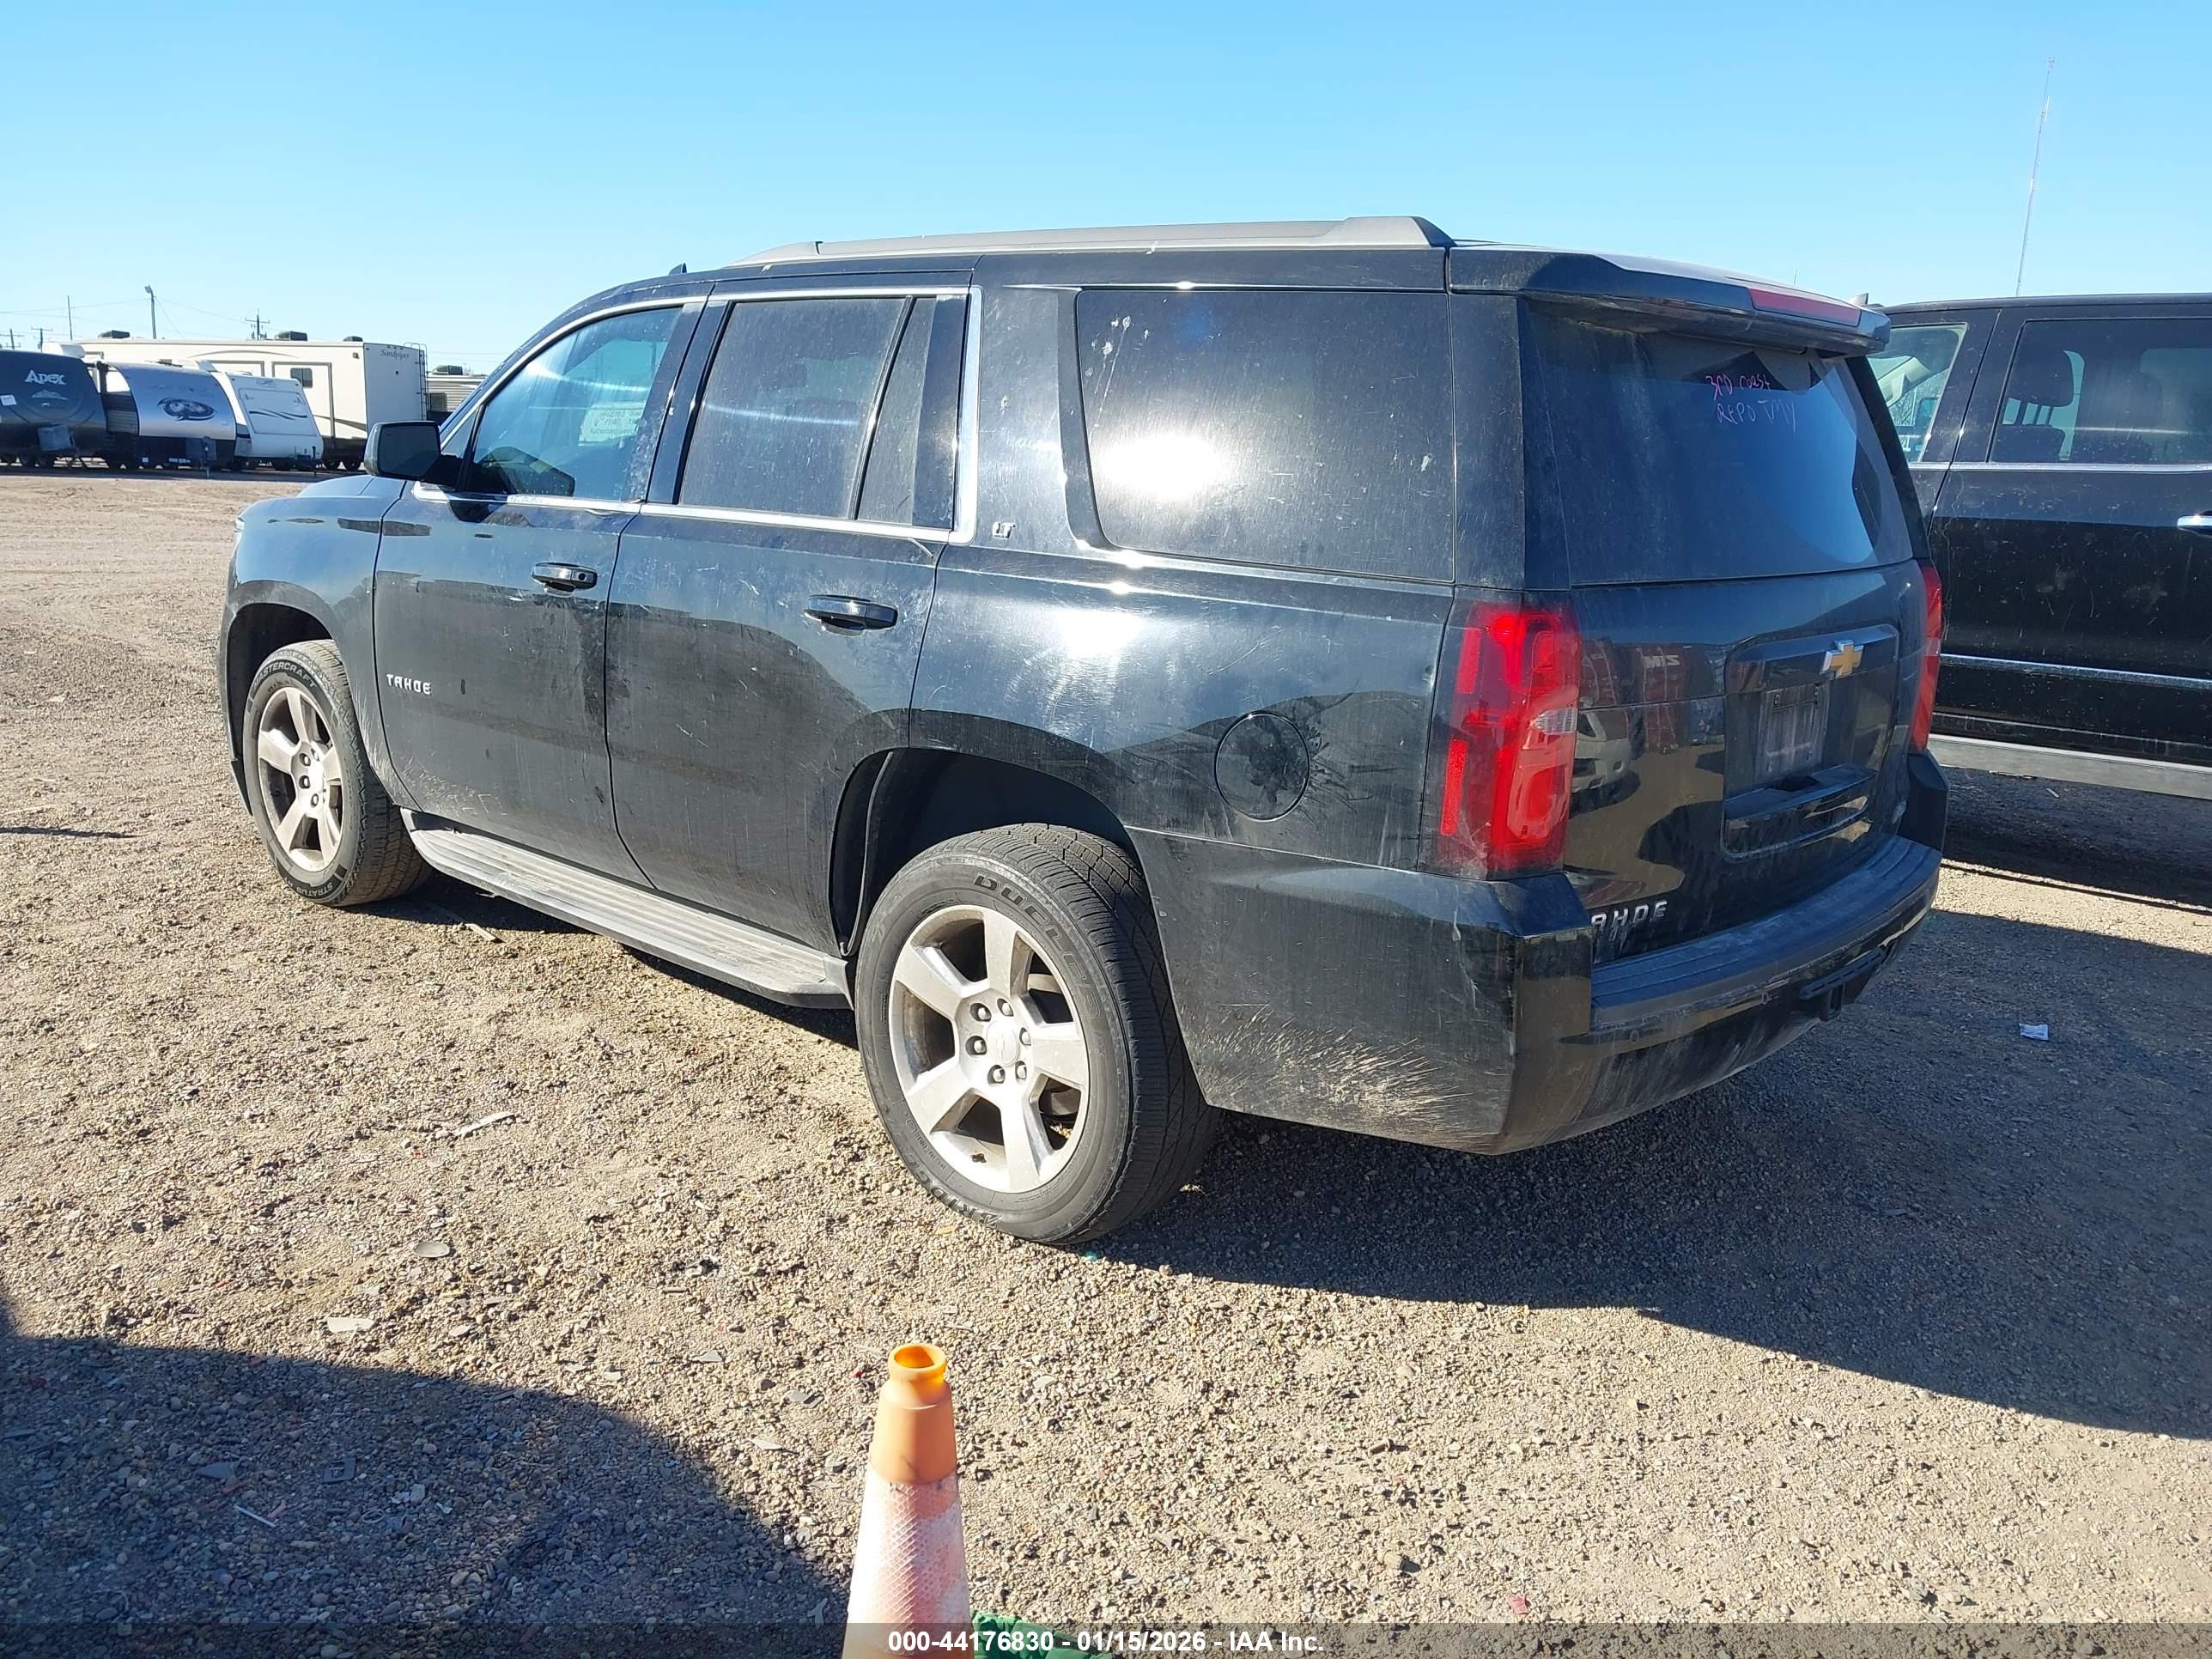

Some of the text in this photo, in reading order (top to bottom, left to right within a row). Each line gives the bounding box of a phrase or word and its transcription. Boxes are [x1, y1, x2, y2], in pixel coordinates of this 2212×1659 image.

[24, 369, 67, 386] Apex
[992, 521, 1016, 540] LT
[252, 661, 317, 690] MASTERCRAFT
[386, 673, 431, 696] TAHOE
[1591, 900, 1668, 933] AHOE
